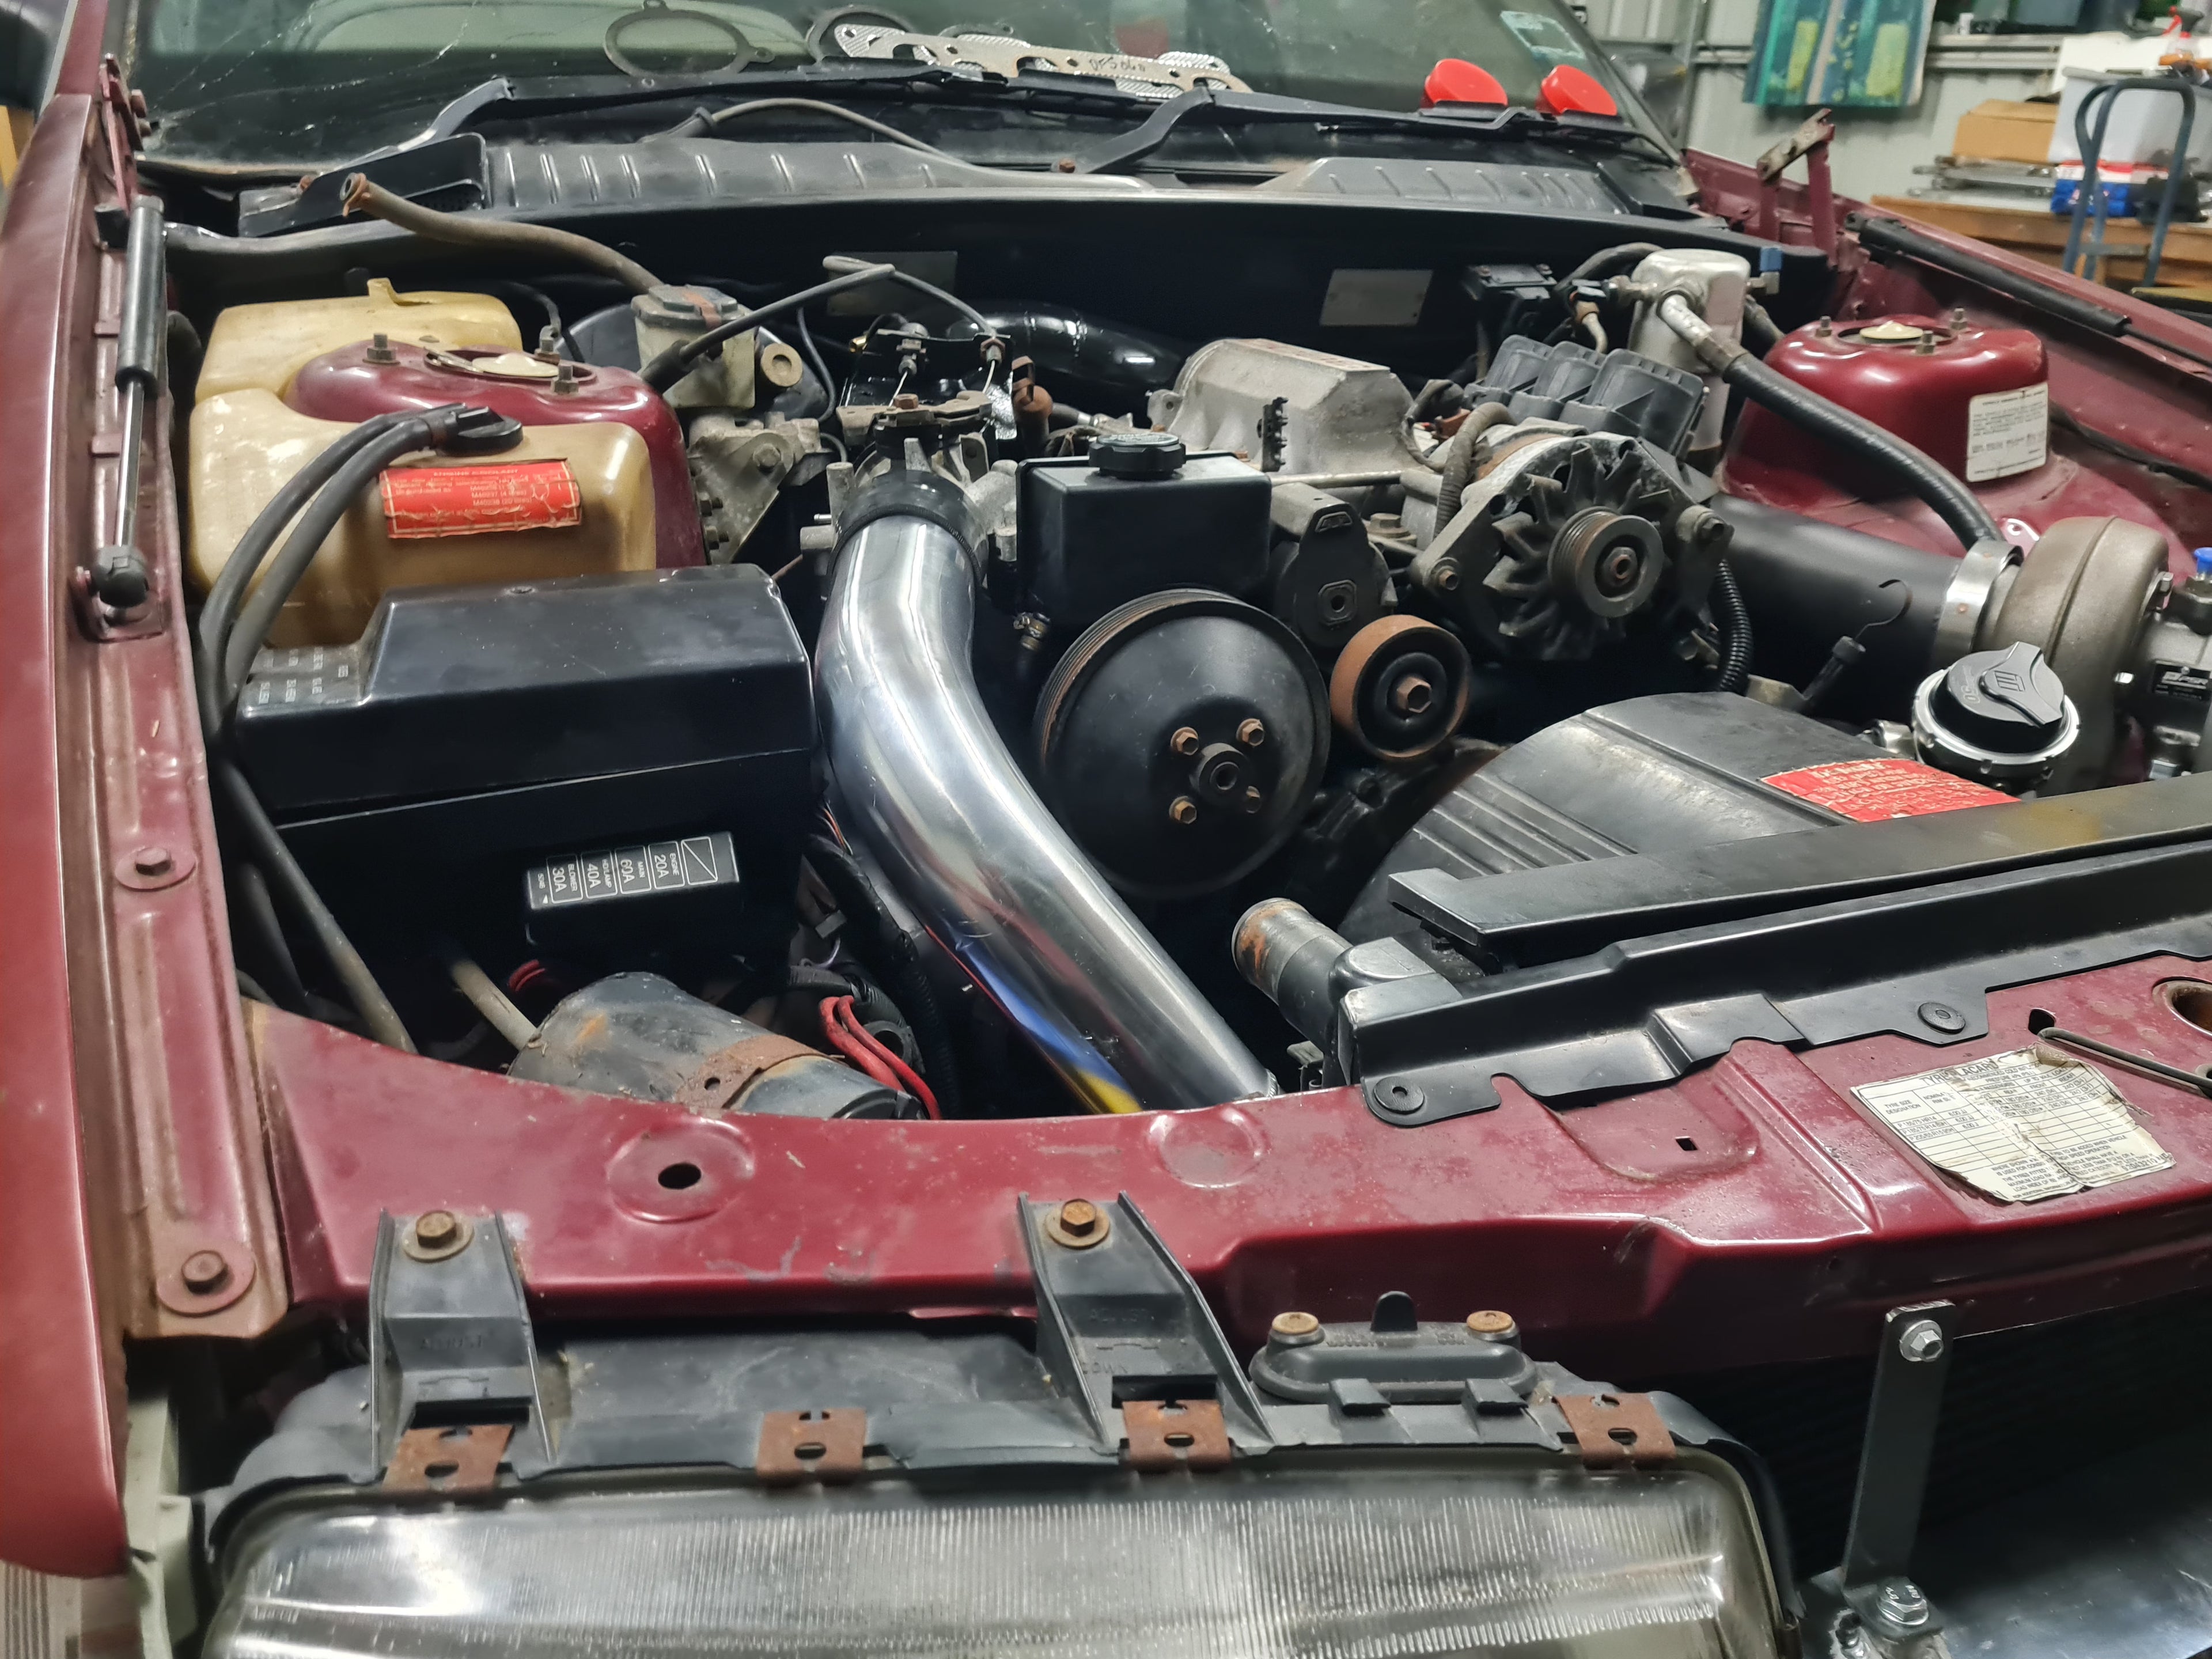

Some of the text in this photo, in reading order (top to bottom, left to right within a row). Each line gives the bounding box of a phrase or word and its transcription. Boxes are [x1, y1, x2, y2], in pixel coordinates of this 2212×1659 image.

[567, 863, 578, 891] BLOWER
[587, 863, 601, 889] 40A
[620, 859, 634, 884] 60A
[638, 861, 646, 878] MAIN
[654, 854, 669, 879] 20A
[552, 867, 567, 892] 30A
[2057, 1073, 2077, 1082] REAR
[1886, 1104, 1921, 1113] DESIGNATION
[2085, 1145, 2111, 1154] OPERATION
